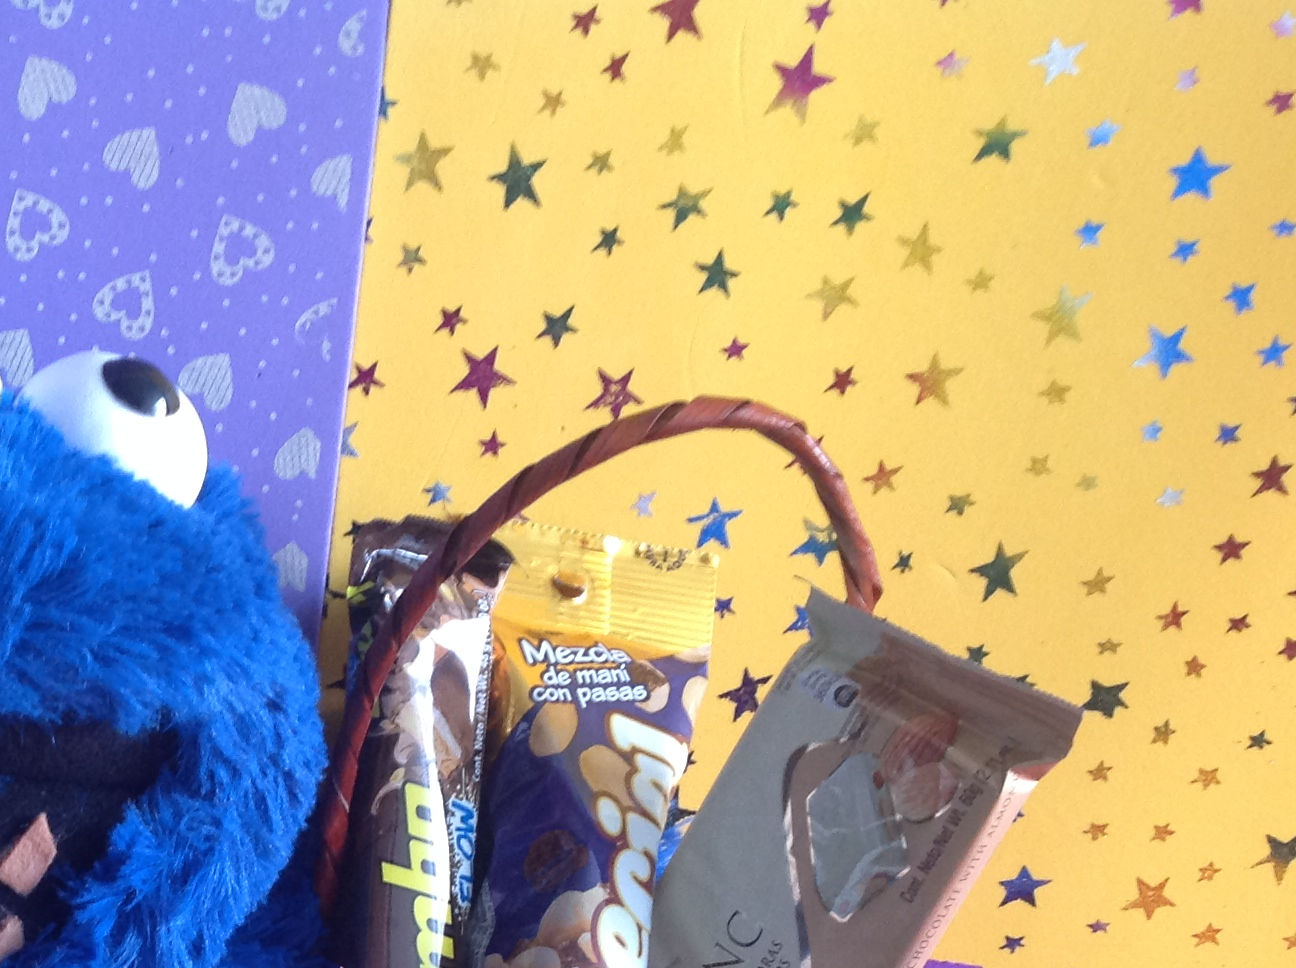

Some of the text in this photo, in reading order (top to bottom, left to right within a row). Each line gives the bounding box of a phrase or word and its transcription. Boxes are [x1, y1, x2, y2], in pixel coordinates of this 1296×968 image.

[519, 638, 632, 667] Mezcla
[543, 665, 629, 686] de maní
[532, 685, 648, 708] con pasas
[473, 721, 485, 750] Neto
